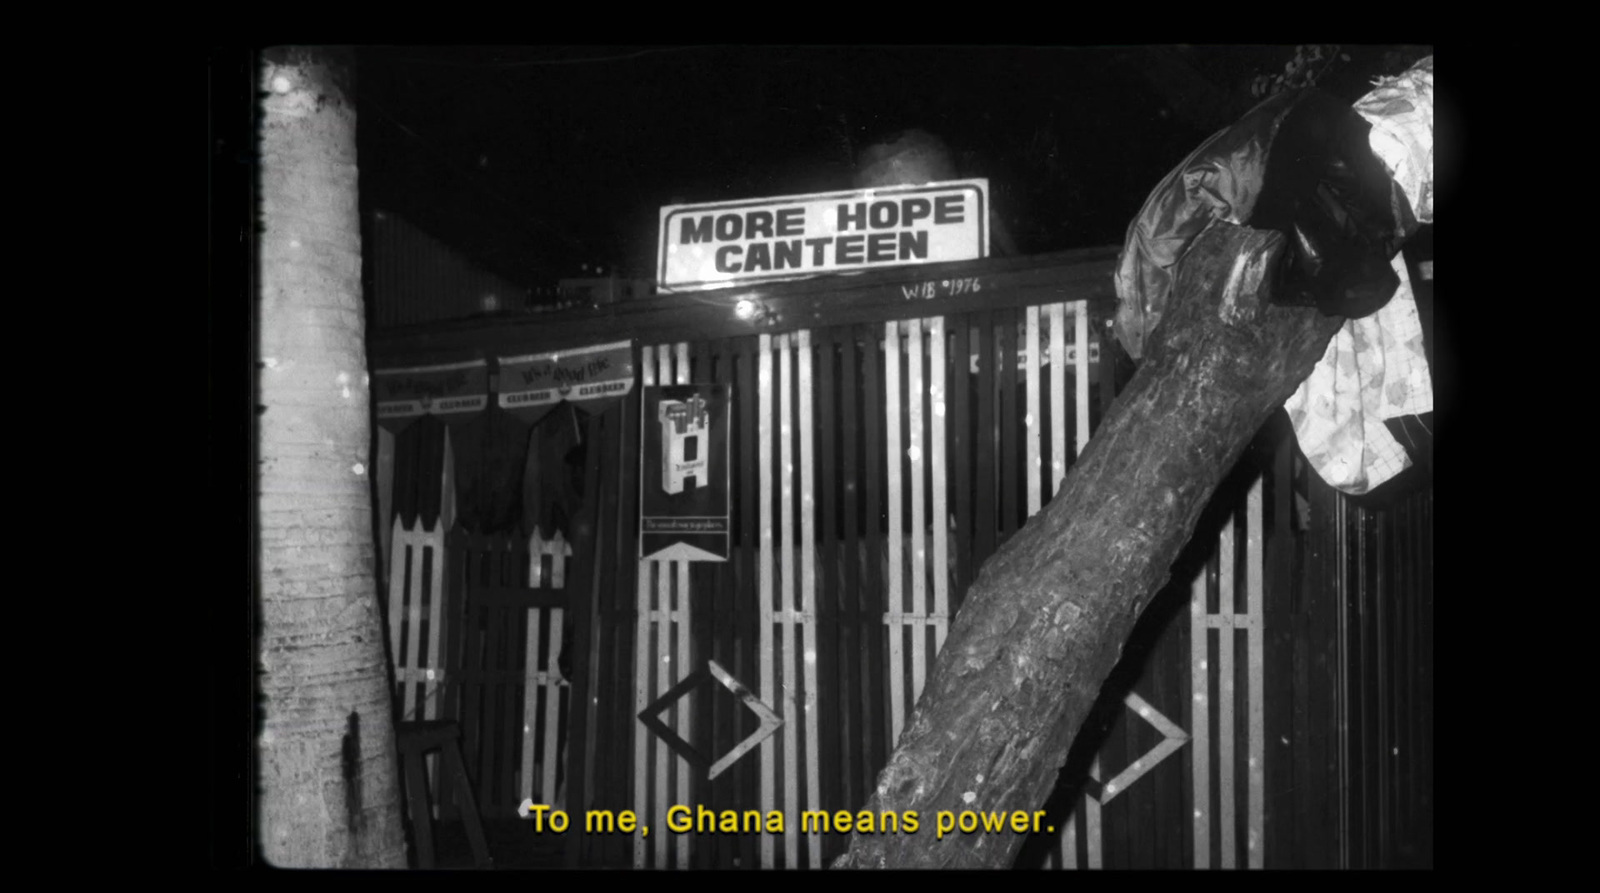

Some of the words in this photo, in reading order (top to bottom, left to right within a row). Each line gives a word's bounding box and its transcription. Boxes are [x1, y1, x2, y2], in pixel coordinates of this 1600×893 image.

[680, 207, 806, 245] MORE
[837, 194, 965, 232] HOPE
[714, 230, 929, 273] CANTEEN
[949, 277, 981, 296] 1976
